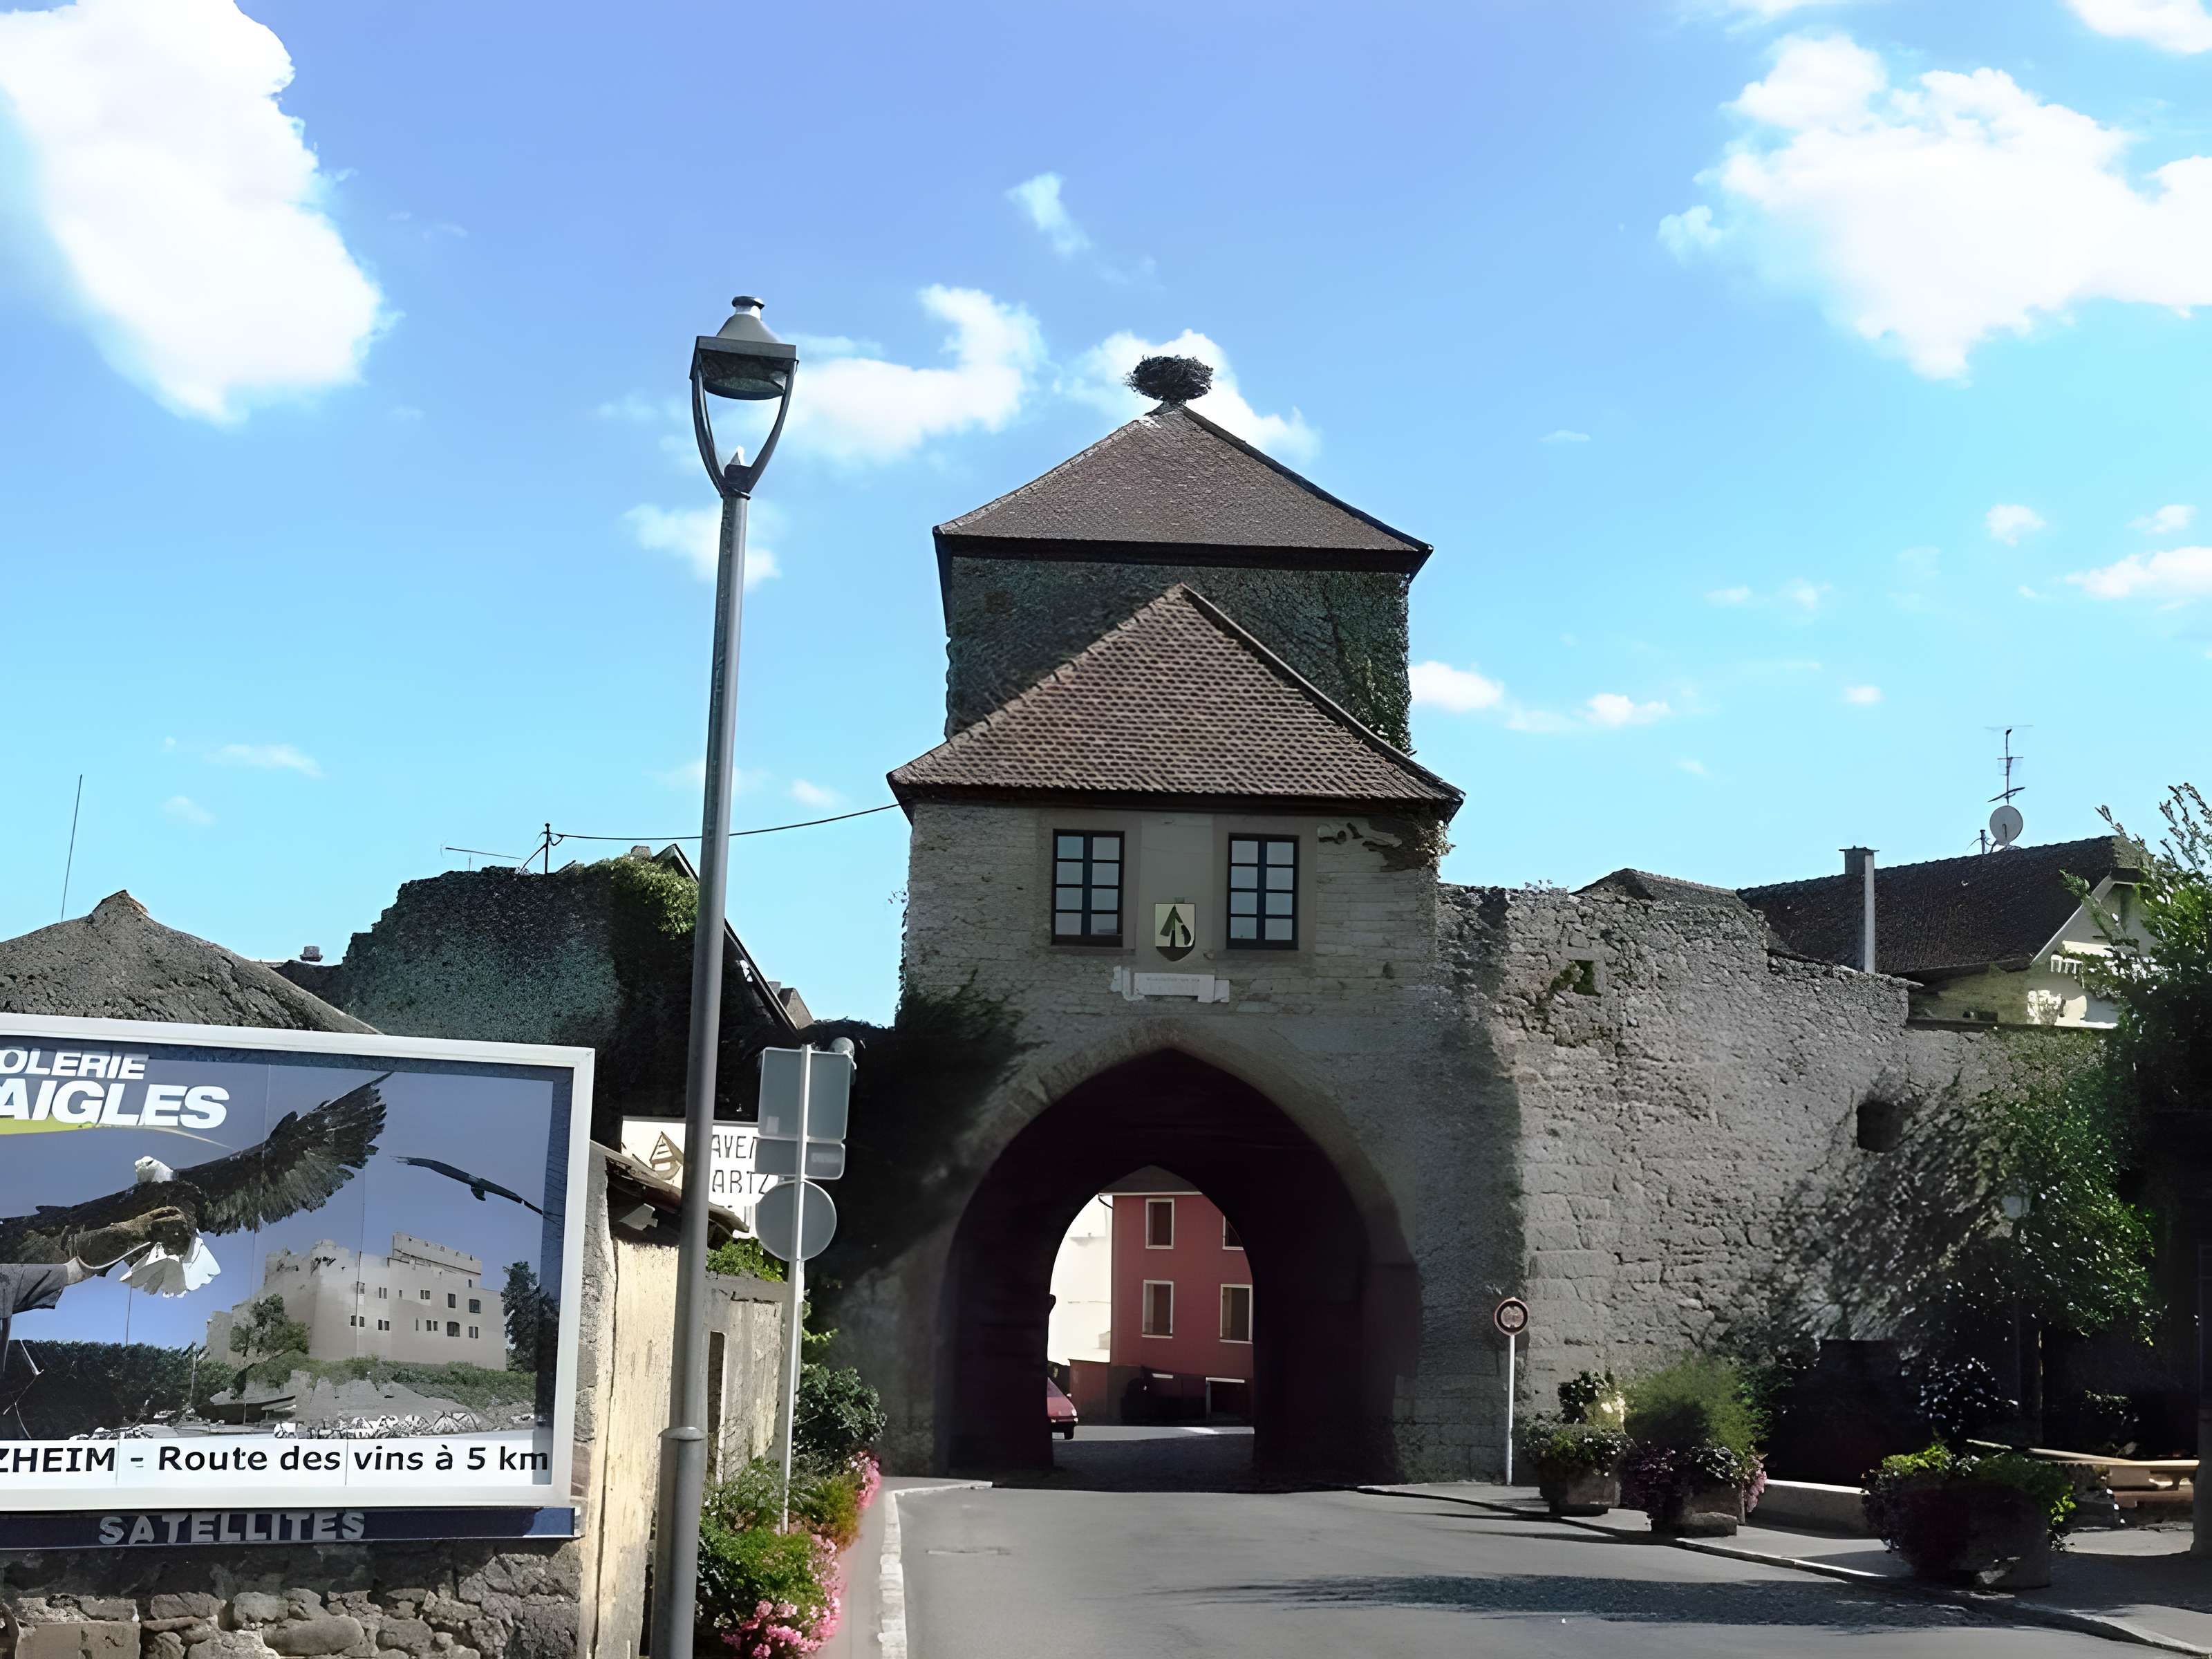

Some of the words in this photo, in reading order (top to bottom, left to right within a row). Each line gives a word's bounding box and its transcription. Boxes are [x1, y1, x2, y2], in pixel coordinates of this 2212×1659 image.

[0, 1047, 149, 1079] OLERIE
[0, 1078, 229, 1129] AIGLES
[159, 1446, 268, 1471] Route
[280, 1445, 340, 1470] des
[354, 1445, 423, 1470] vins
[435, 1444, 453, 1470] à
[467, 1447, 486, 1470] 5
[500, 1446, 548, 1470] km
[99, 1512, 365, 1545] SATELLITES
